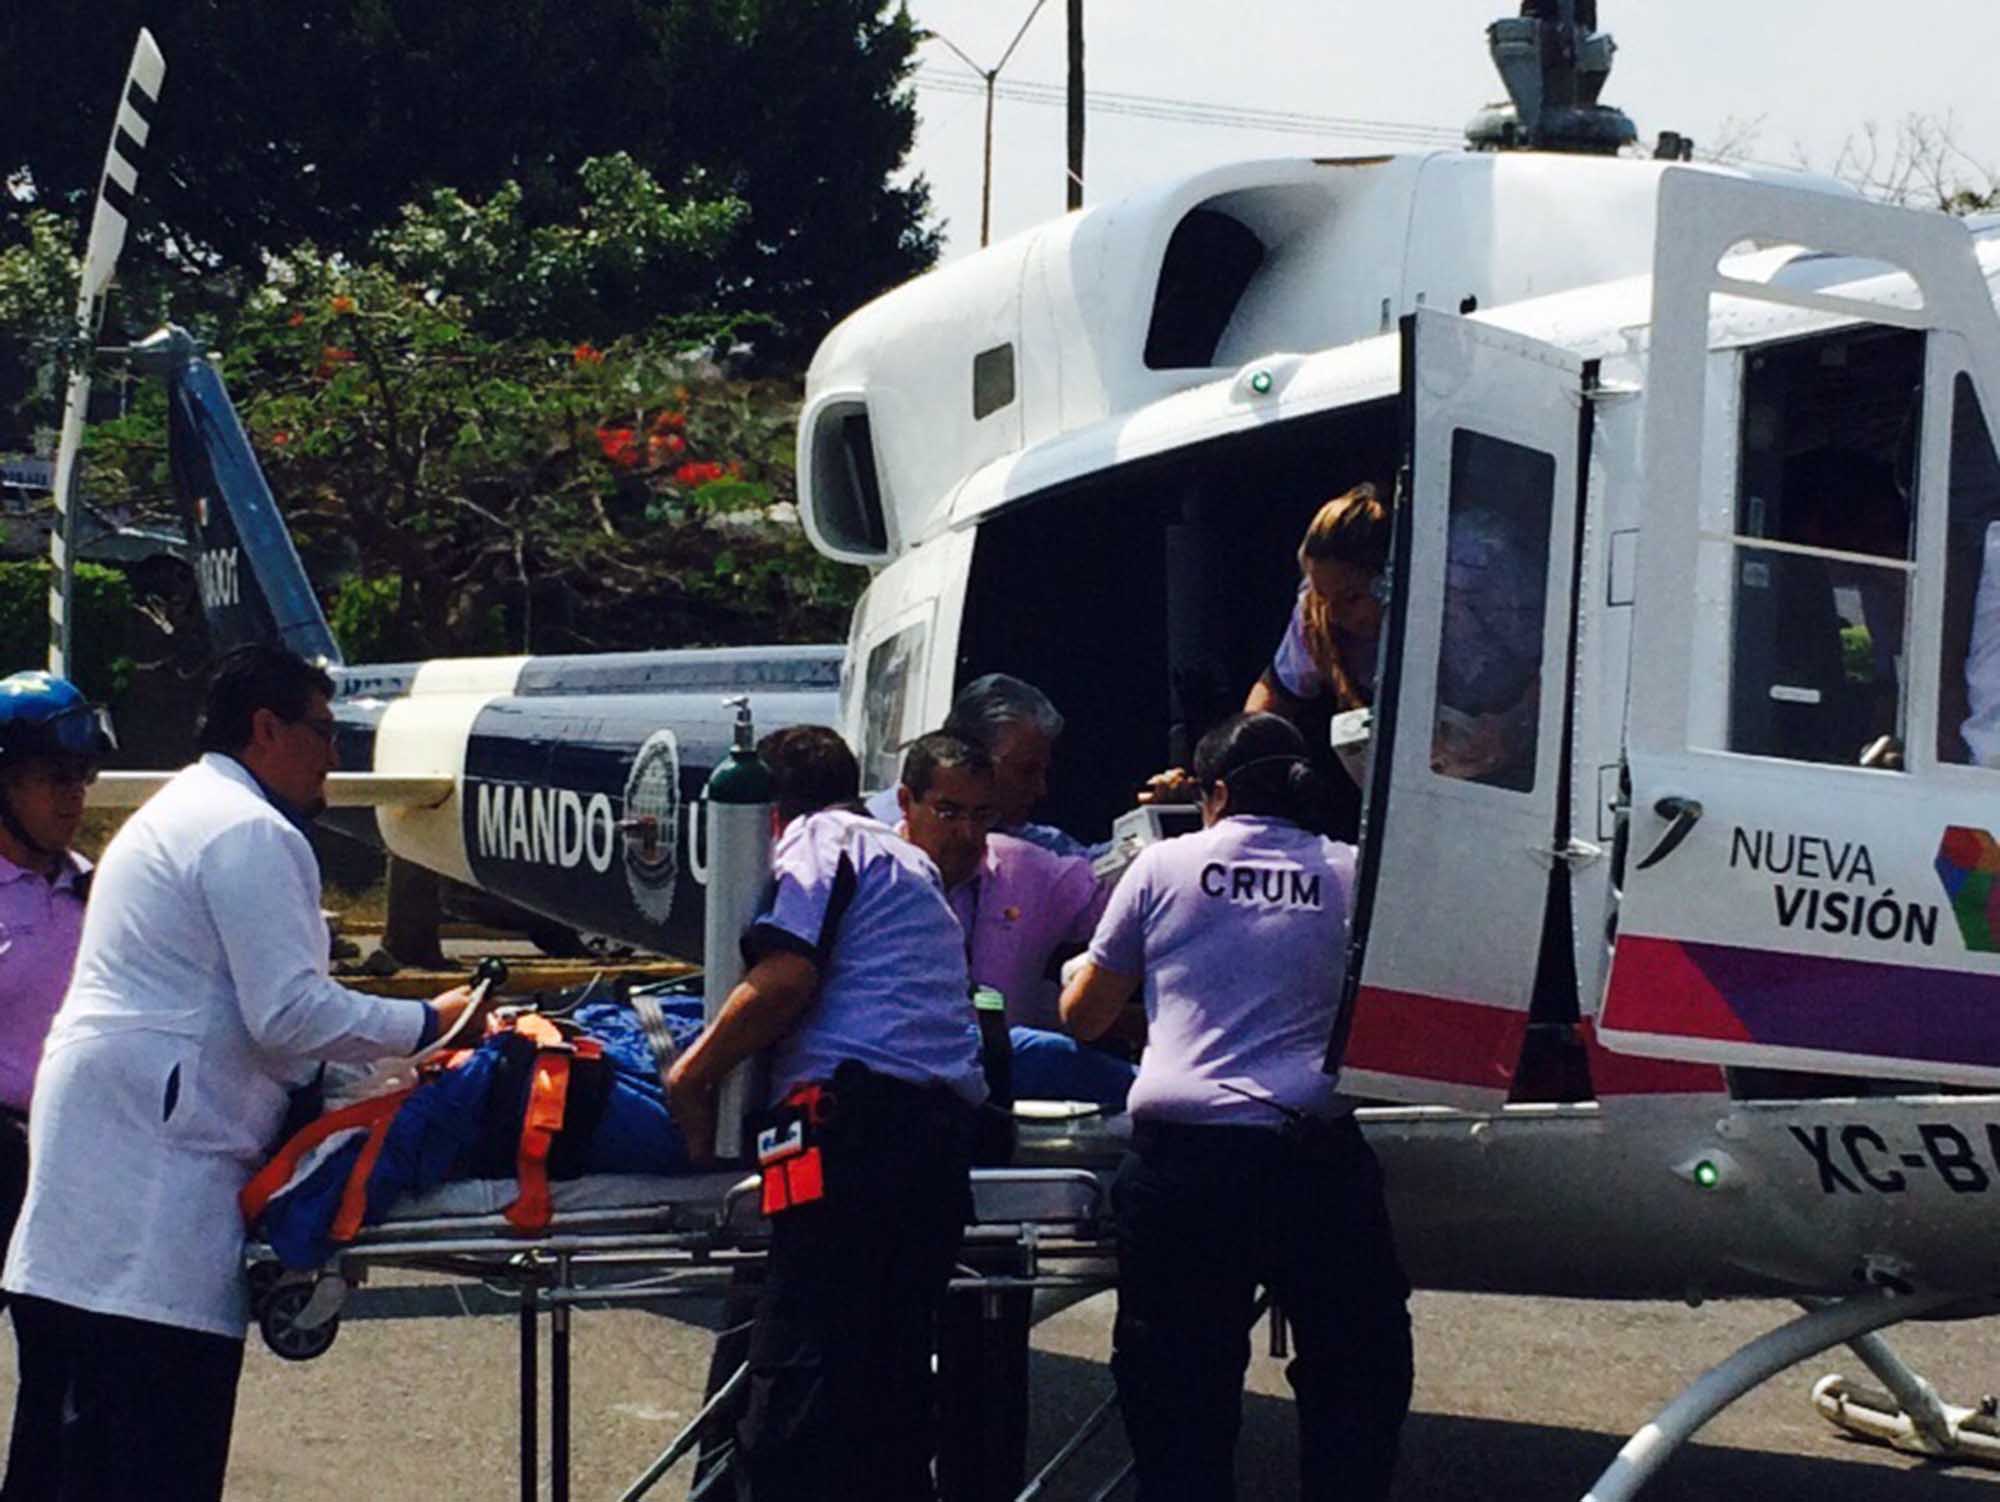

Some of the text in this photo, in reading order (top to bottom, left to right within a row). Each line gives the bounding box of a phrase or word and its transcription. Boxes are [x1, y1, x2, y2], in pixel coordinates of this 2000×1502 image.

[478, 783, 613, 873] MANDO
[1729, 826, 1876, 886] NUEVA
[1201, 862, 1321, 907] CRUM
[1773, 884, 1939, 946] VISIÓN
[1787, 1123, 2000, 1194] XC-B
